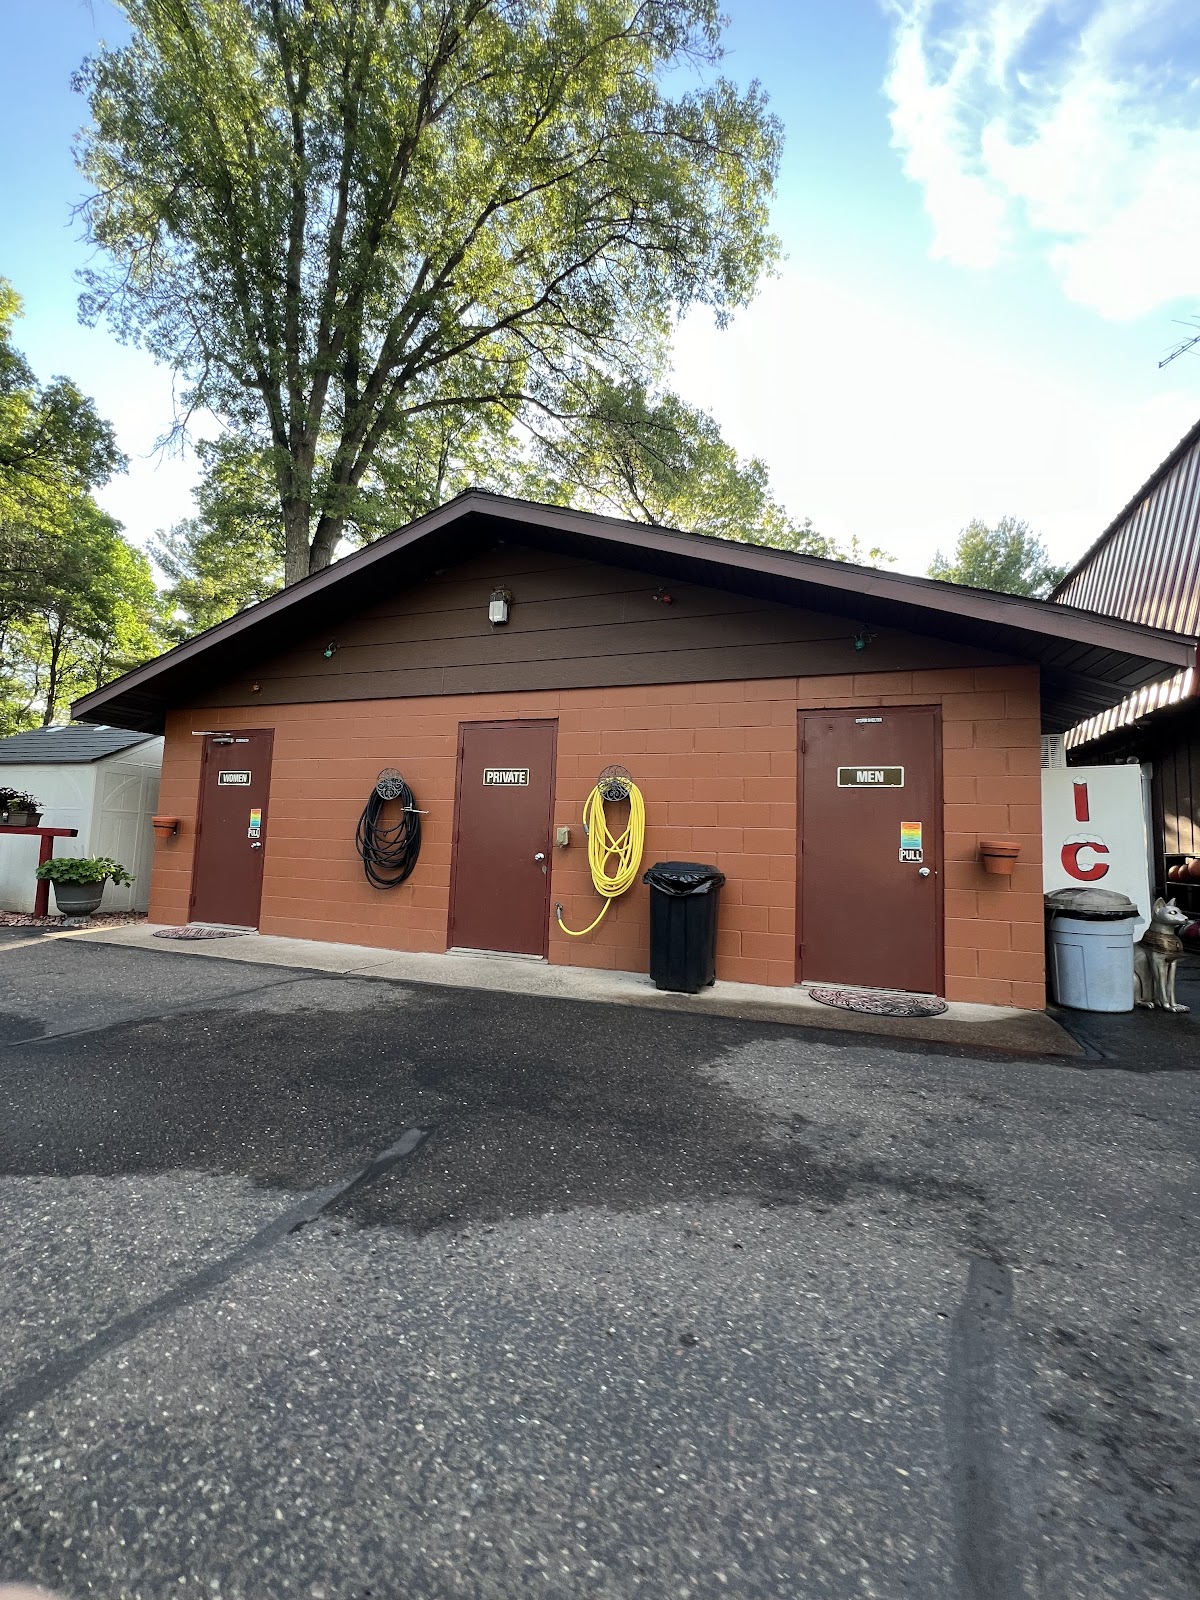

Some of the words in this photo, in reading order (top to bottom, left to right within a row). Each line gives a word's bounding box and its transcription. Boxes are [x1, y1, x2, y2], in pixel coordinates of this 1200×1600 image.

[223, 774, 247, 783] WOMEN
[487, 771, 526, 783] PRIVATE
[856, 771, 884, 783] MEN
[1060, 775, 1110, 882] IC
[900, 850, 922, 860] PULL
